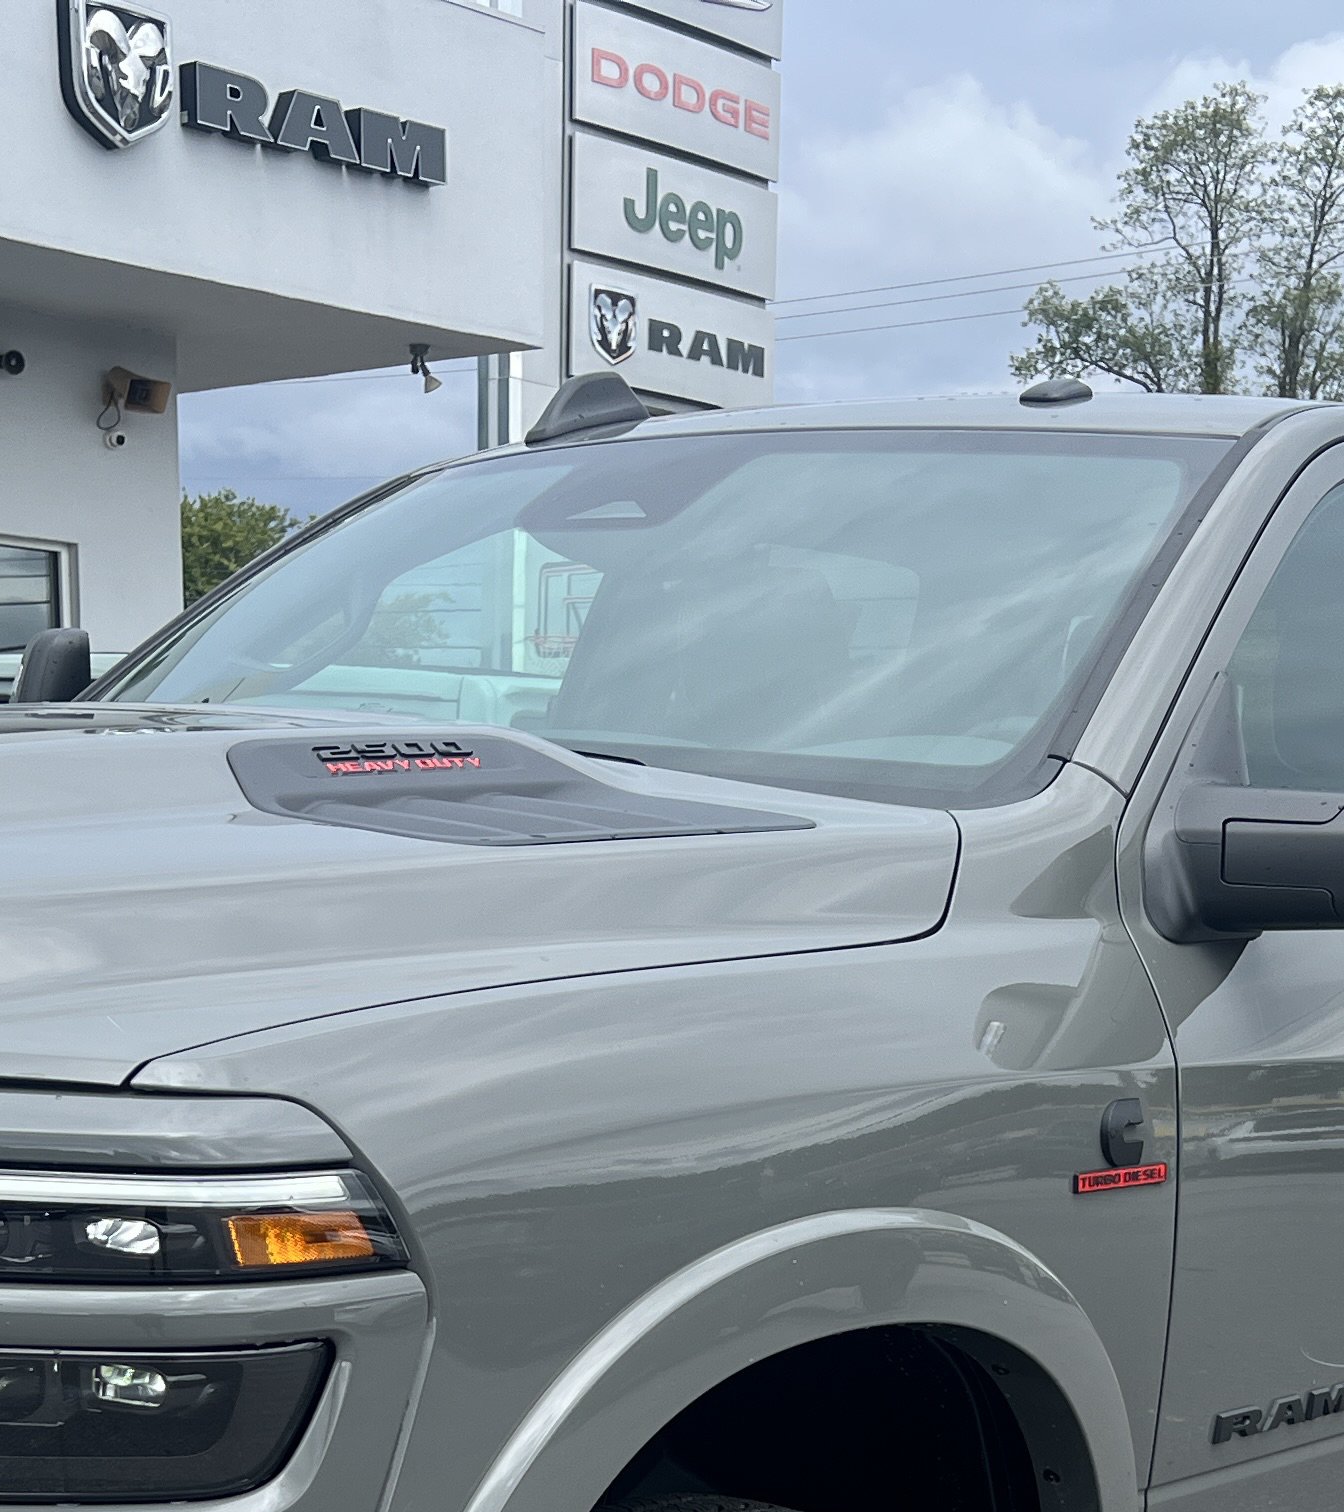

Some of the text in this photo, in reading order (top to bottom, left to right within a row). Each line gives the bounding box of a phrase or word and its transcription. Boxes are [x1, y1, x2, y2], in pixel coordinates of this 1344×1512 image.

[180, 60, 448, 187] RAM
[591, 47, 771, 141] DODGE
[623, 167, 743, 270] Jeep
[647, 318, 766, 378] RAM
[311, 741, 474, 763] 2500
[324, 757, 481, 776] HEAVY DUTY
[1080, 1167, 1164, 1189] TURBO DIESEL
